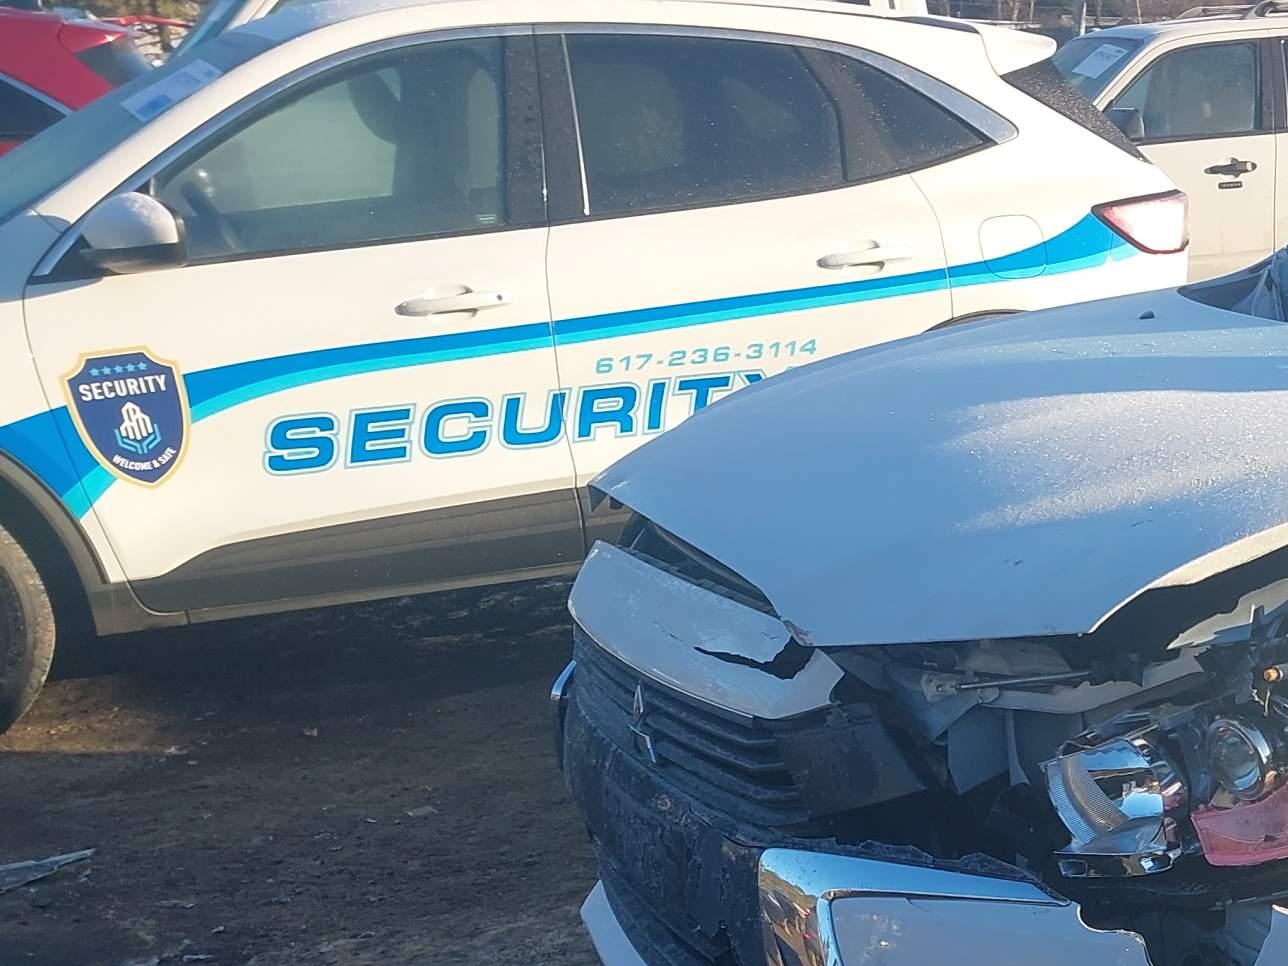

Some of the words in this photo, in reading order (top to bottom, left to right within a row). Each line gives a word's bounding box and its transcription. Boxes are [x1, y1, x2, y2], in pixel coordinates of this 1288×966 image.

[595, 338, 817, 374] 617-236-3114
[78, 374, 167, 402] SECURITY
[264, 367, 798, 476] SECURIT
[112, 454, 153, 471] WELCOME
[151, 459, 161, 468] &
[157, 446, 177, 465] SAFE
